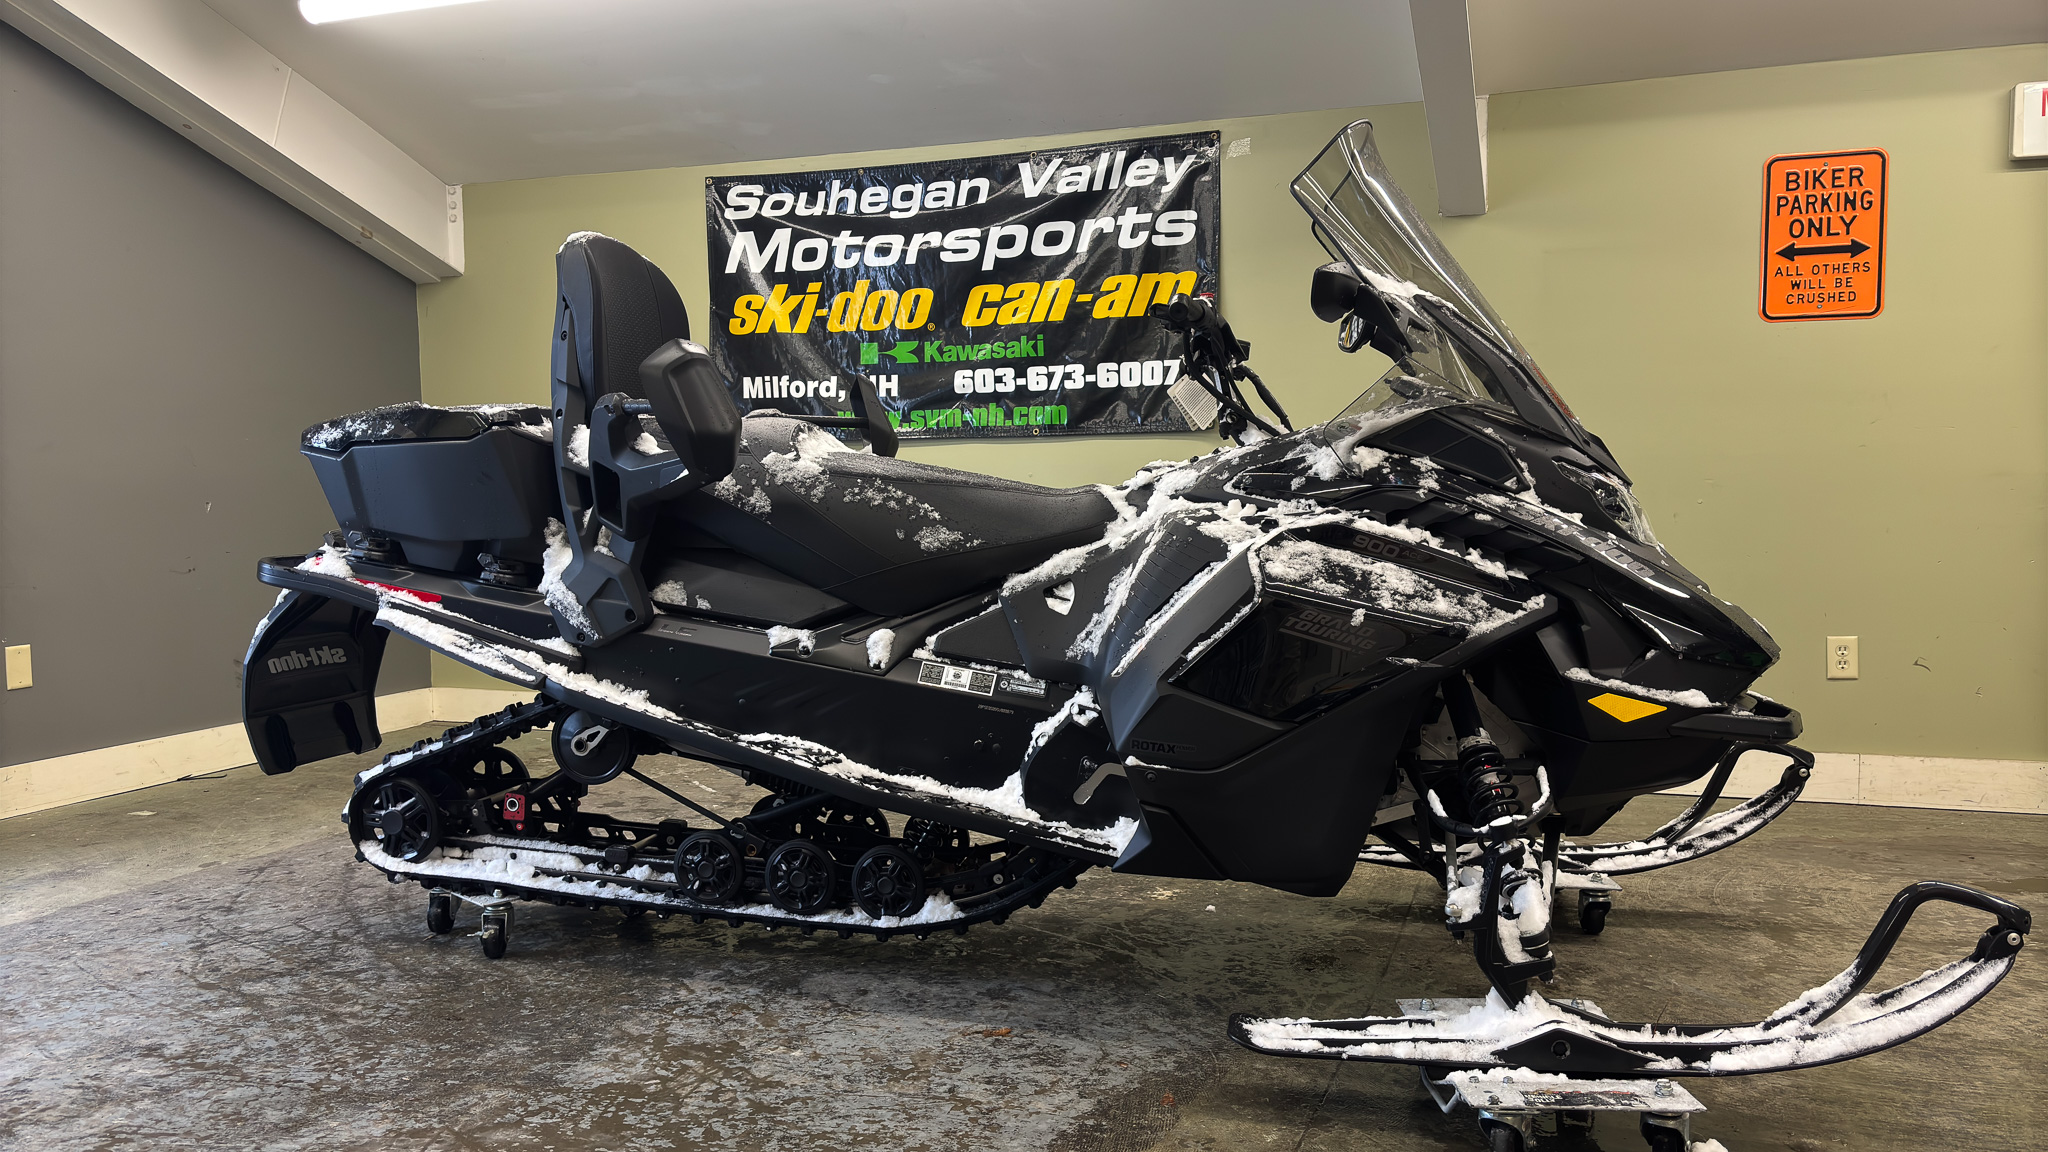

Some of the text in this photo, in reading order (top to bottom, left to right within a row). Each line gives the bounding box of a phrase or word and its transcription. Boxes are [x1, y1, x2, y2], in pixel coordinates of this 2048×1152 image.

[724, 150, 1200, 221] Souhegan Valley
[1785, 167, 1865, 192] BIKER
[1776, 190, 1873, 216] PARKING
[724, 206, 1199, 274] Motorsports
[1788, 214, 1858, 239] ONLY
[1774, 261, 1871, 278] ALL OTHERS
[1790, 276, 1854, 291] WILL BE
[961, 270, 1198, 327] can-am
[1786, 291, 1857, 305] CRUSHED
[924, 334, 1045, 364] Kawasaki
[742, 374, 899, 403] Milford, H
[953, 359, 1183, 395] 603-673-6007
[837, 402, 1068, 430] w.svm-nh.com
[1352, 533, 1425, 561] 900 ACE
[1283, 616, 1377, 650] TOURING
[1298, 609, 1376, 637] GRAND
[1131, 739, 1176, 754] ROTAX
